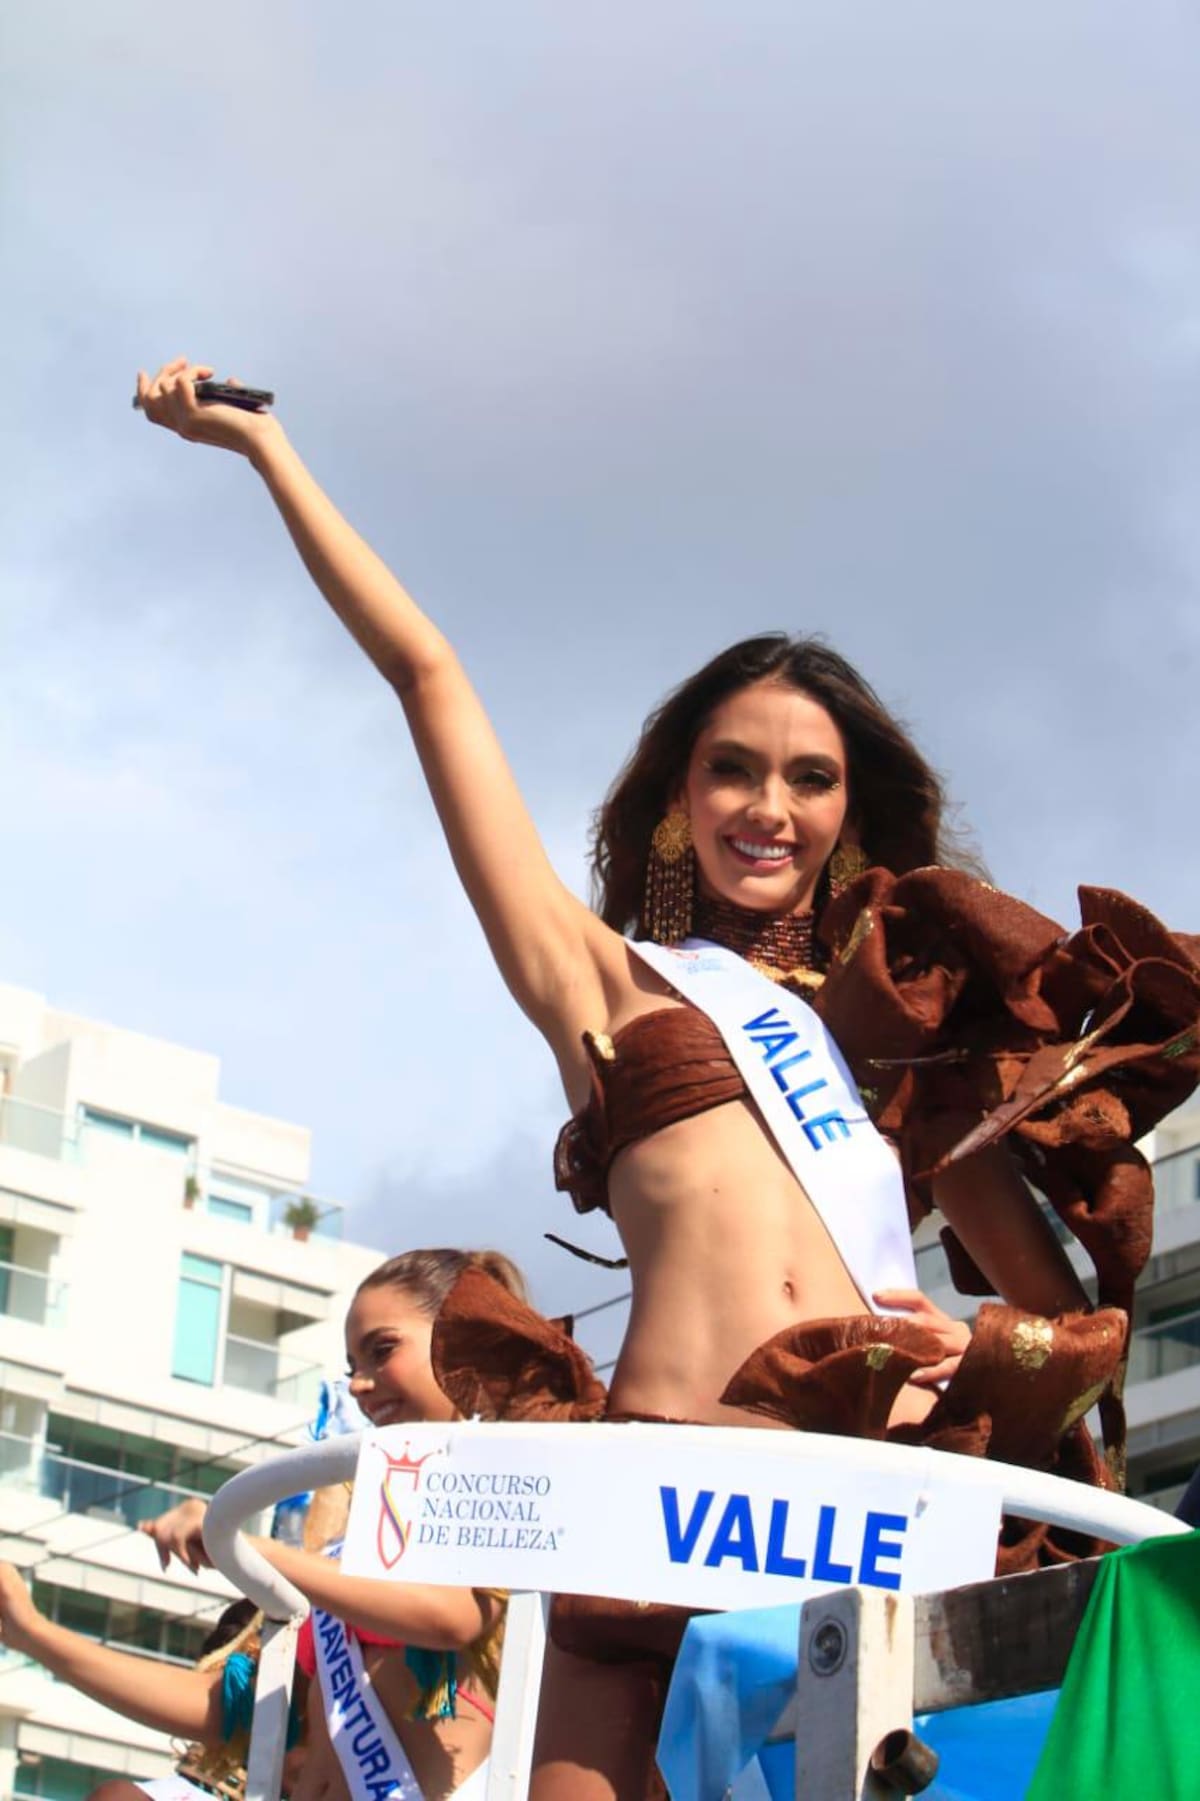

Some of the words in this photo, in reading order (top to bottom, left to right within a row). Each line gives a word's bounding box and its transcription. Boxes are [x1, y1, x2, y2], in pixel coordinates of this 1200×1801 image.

[742, 1008, 851, 1152] VALLE
[426, 1472, 552, 1497] CONCURSO
[421, 1497, 541, 1522] NACIONAL
[417, 1523, 451, 1546] DE
[659, 1485, 908, 1591] VALLE
